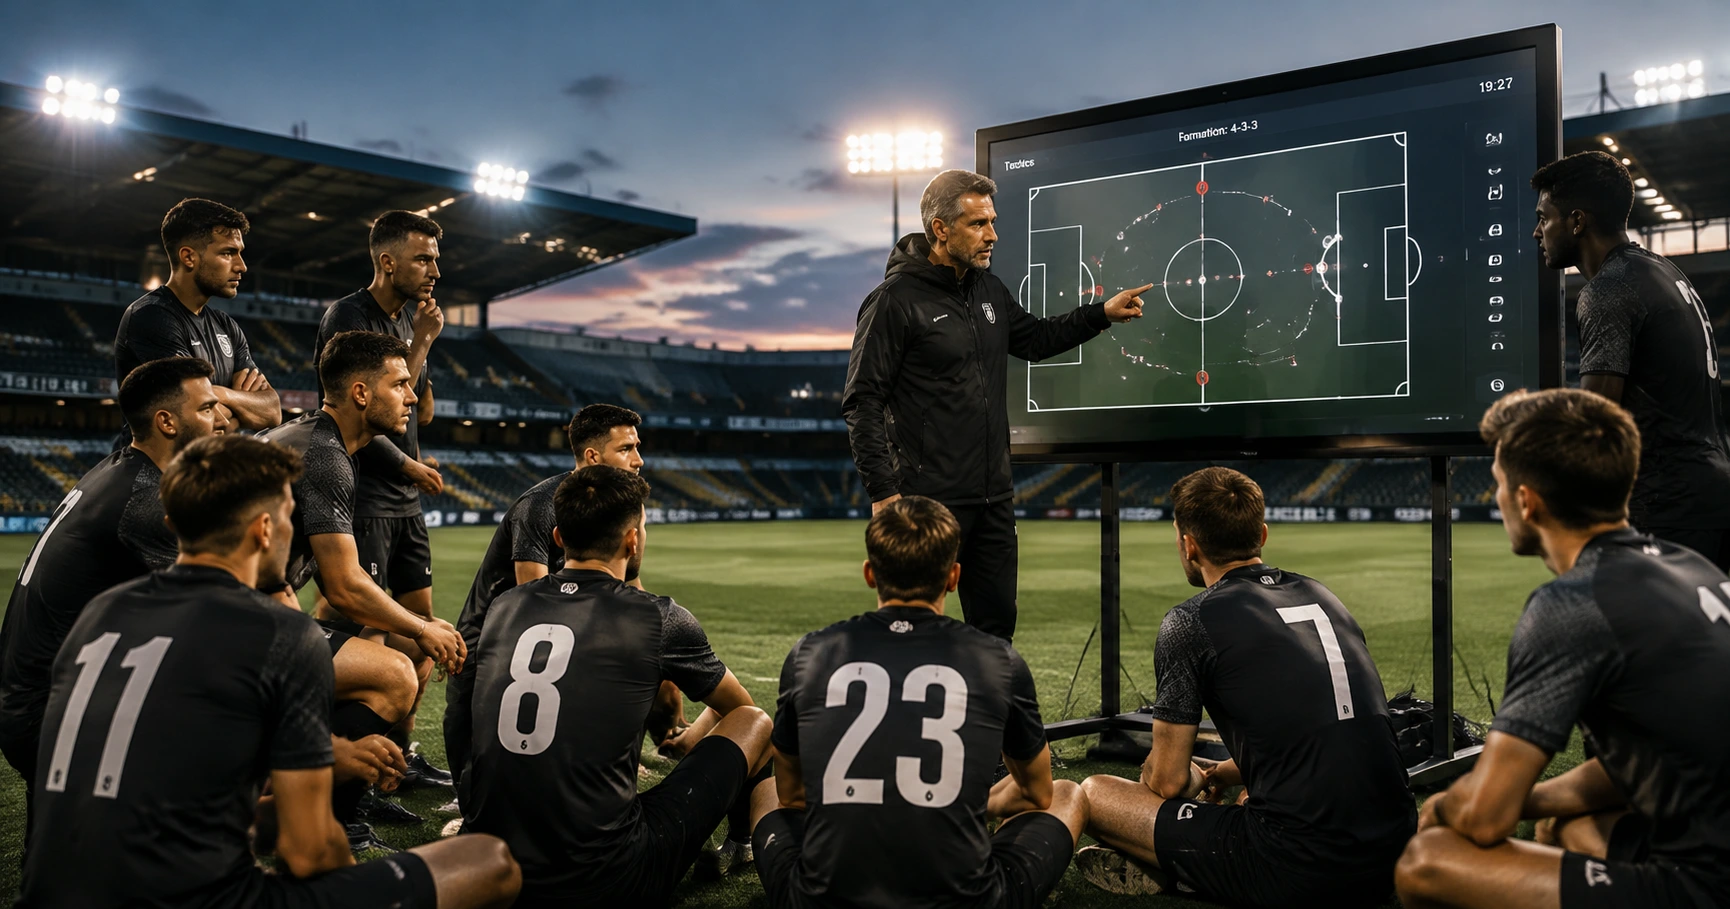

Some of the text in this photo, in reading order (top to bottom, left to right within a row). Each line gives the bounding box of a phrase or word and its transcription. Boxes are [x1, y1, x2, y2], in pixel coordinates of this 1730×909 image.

[1178, 120, 1258, 142] Formation: 4-3-3
[1479, 76, 1513, 93] 19:27
[45, 631, 173, 798] 11
[497, 623, 576, 755] 8
[1276, 603, 1354, 721] 7
[822, 661, 969, 808] 23
